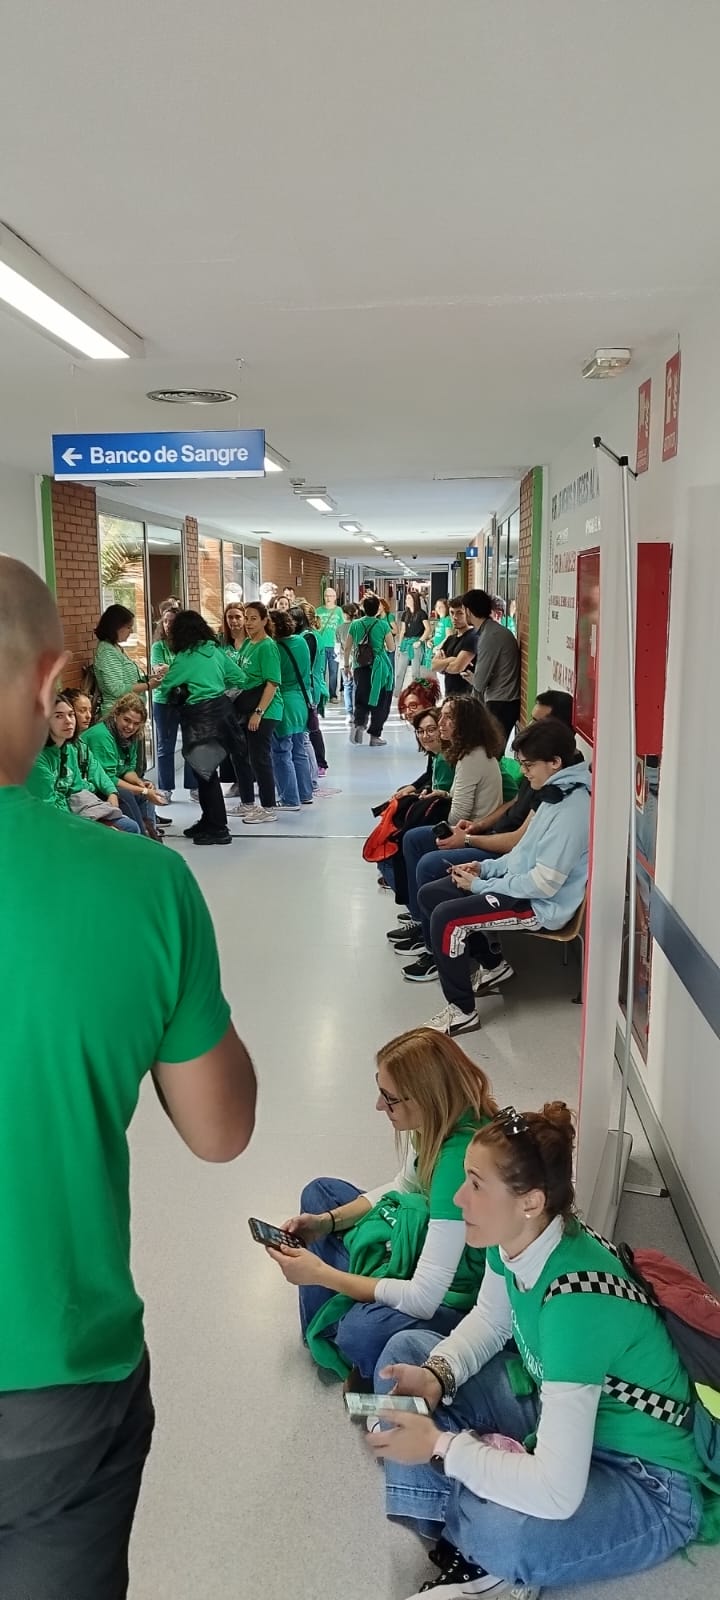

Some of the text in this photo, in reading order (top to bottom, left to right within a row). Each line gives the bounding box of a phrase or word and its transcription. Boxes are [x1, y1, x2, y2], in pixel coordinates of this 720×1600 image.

[90, 444, 249, 466] Banco de Sangre
